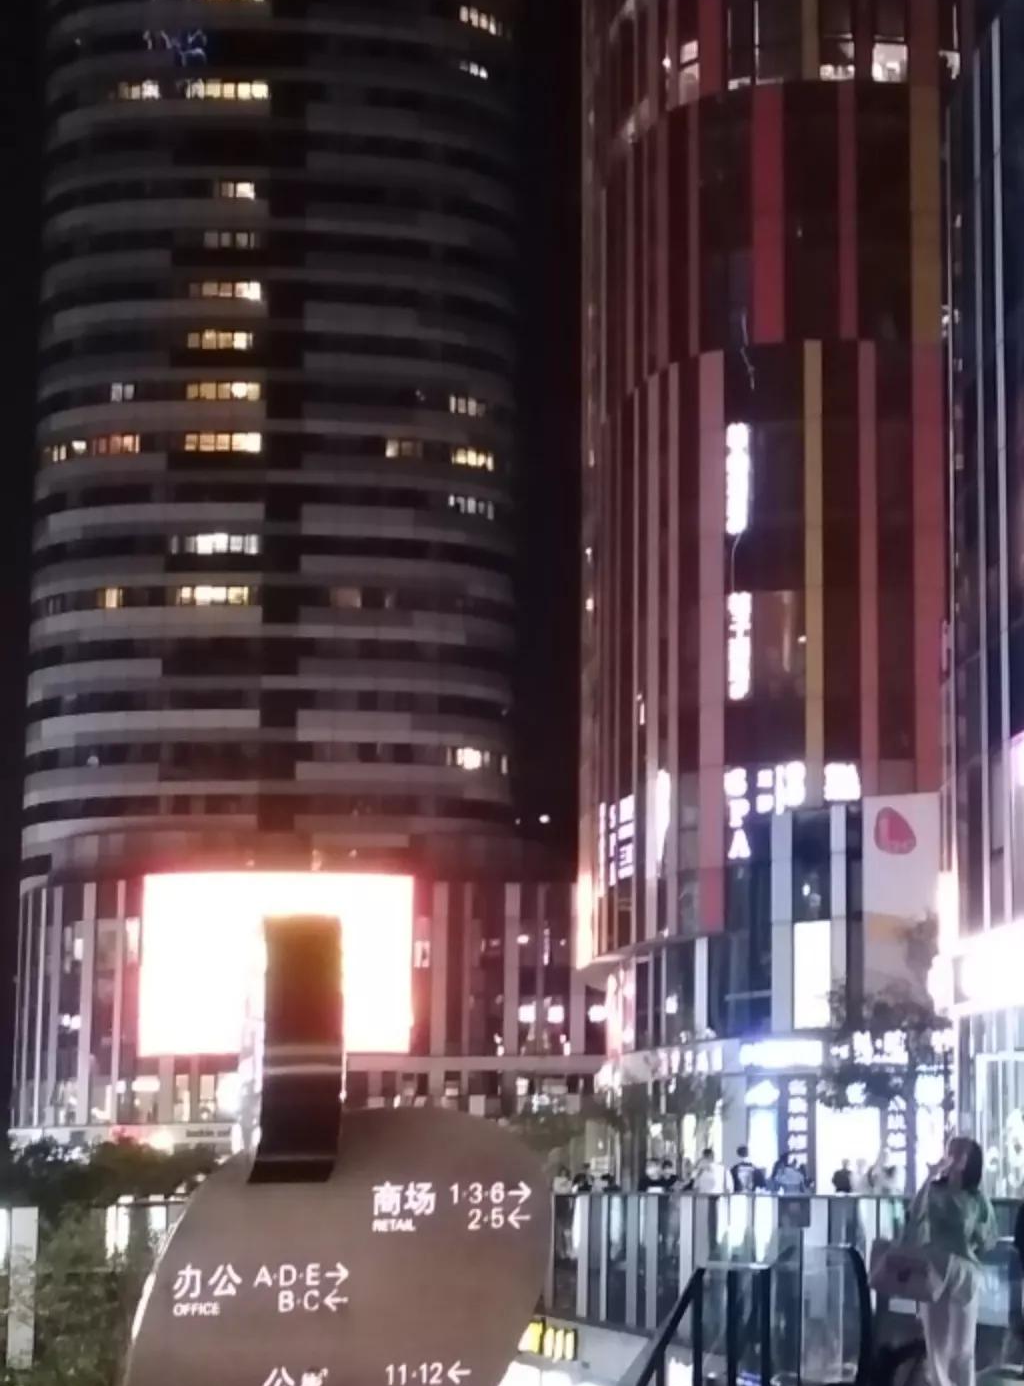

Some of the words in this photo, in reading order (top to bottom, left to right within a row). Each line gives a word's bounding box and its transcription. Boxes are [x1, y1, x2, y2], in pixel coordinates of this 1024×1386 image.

[371, 1181, 437, 1216] 商场
[371, 1218, 416, 1232] RETAIL
[172, 1263, 243, 1300] 办公
[172, 1302, 221, 1317] OFFICE
